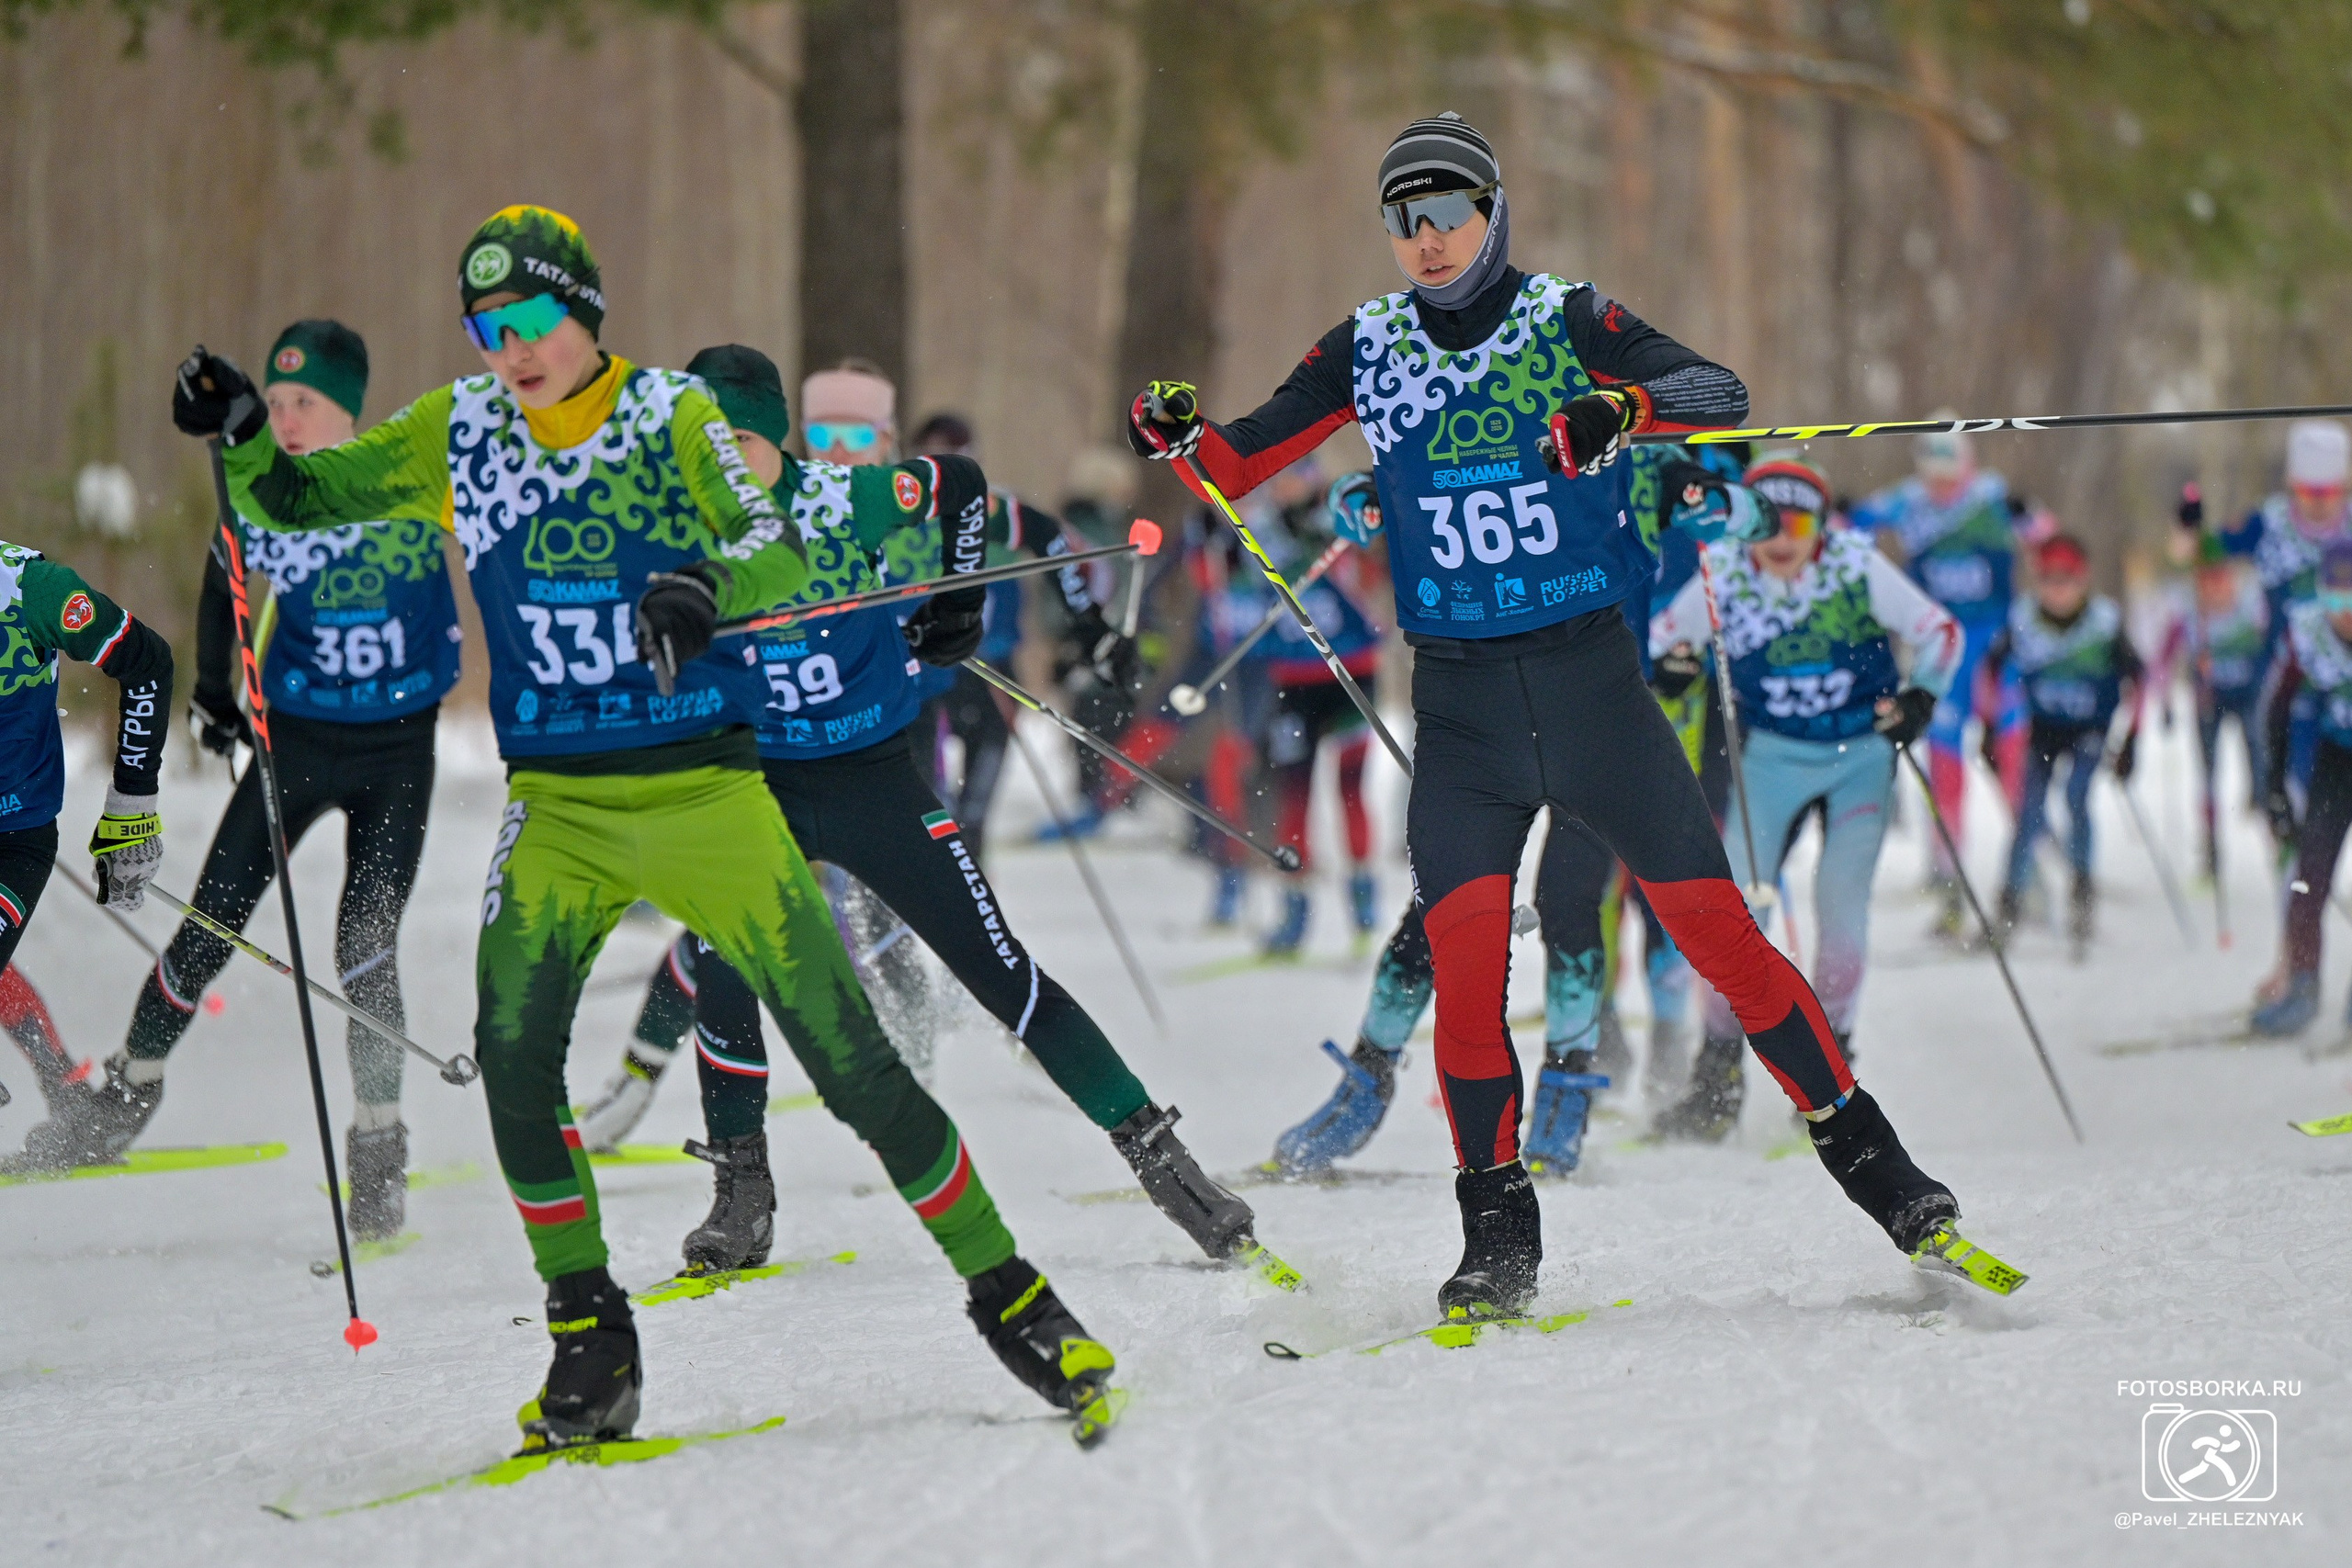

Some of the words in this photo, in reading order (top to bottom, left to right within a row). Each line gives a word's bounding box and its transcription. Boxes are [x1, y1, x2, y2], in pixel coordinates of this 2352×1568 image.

[1386, 176, 1432, 198] NORDSKI
[522, 256, 606, 312] TATASTA
[1460, 460, 1523, 485] KAMAZ
[952, 494, 985, 574] АГРЫЗ
[1417, 479, 1560, 570] 365
[1539, 565, 1606, 595] RUSSIA
[310, 616, 406, 679] 361
[948, 840, 1020, 970] ТАТАРСТАН
